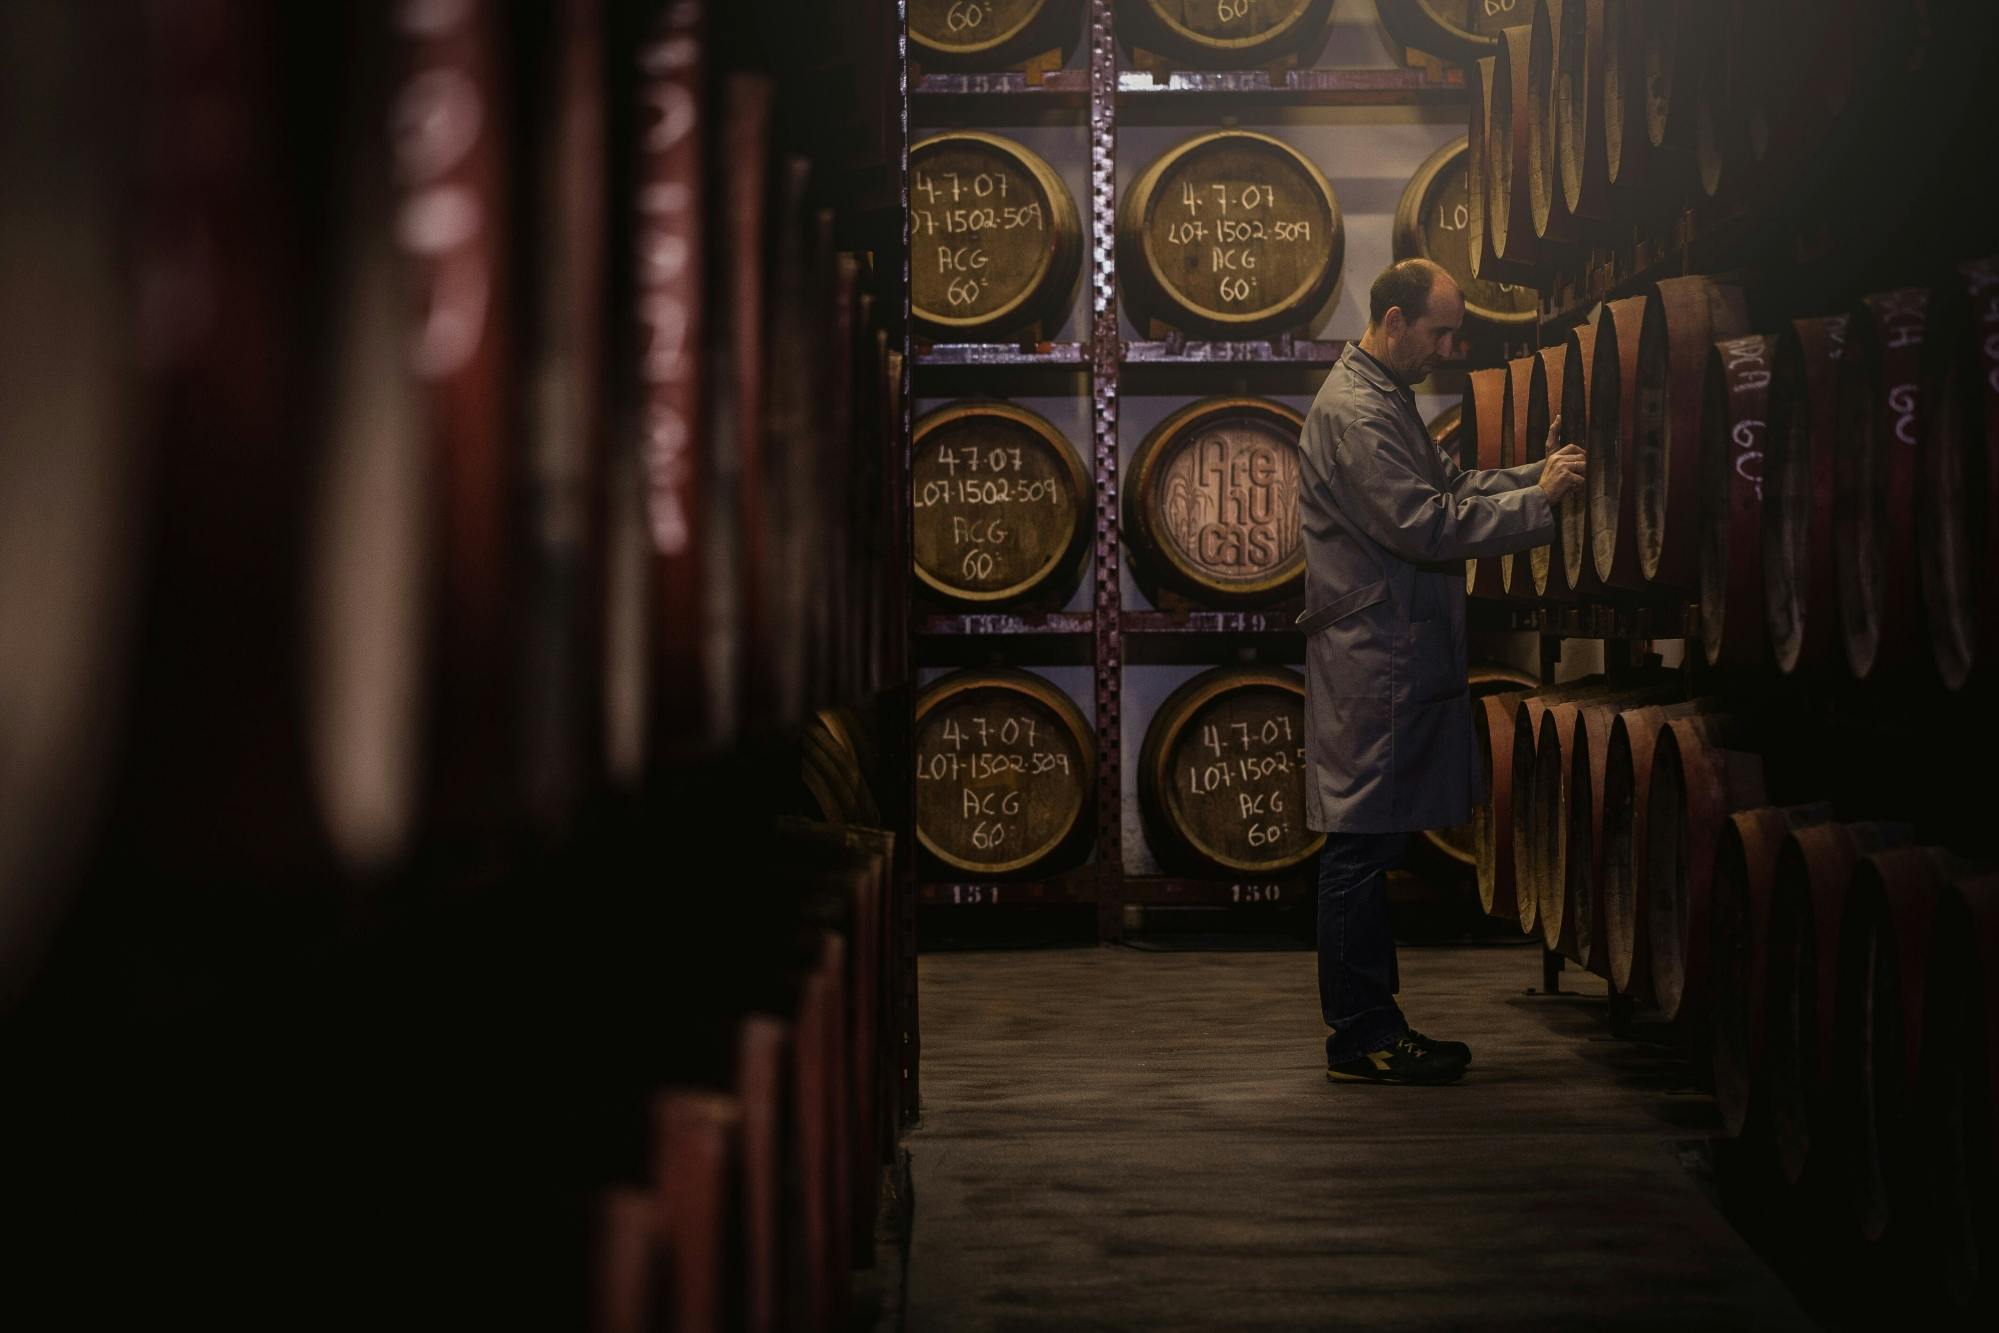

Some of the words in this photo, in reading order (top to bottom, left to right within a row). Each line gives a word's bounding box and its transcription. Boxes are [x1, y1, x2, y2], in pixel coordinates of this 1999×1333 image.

[938, 246, 989, 273] ACG
[1212, 246, 1256, 272] ACG
[953, 516, 1009, 544] ACG
[963, 788, 1020, 819] ACG
[1239, 791, 1284, 819] ACG
